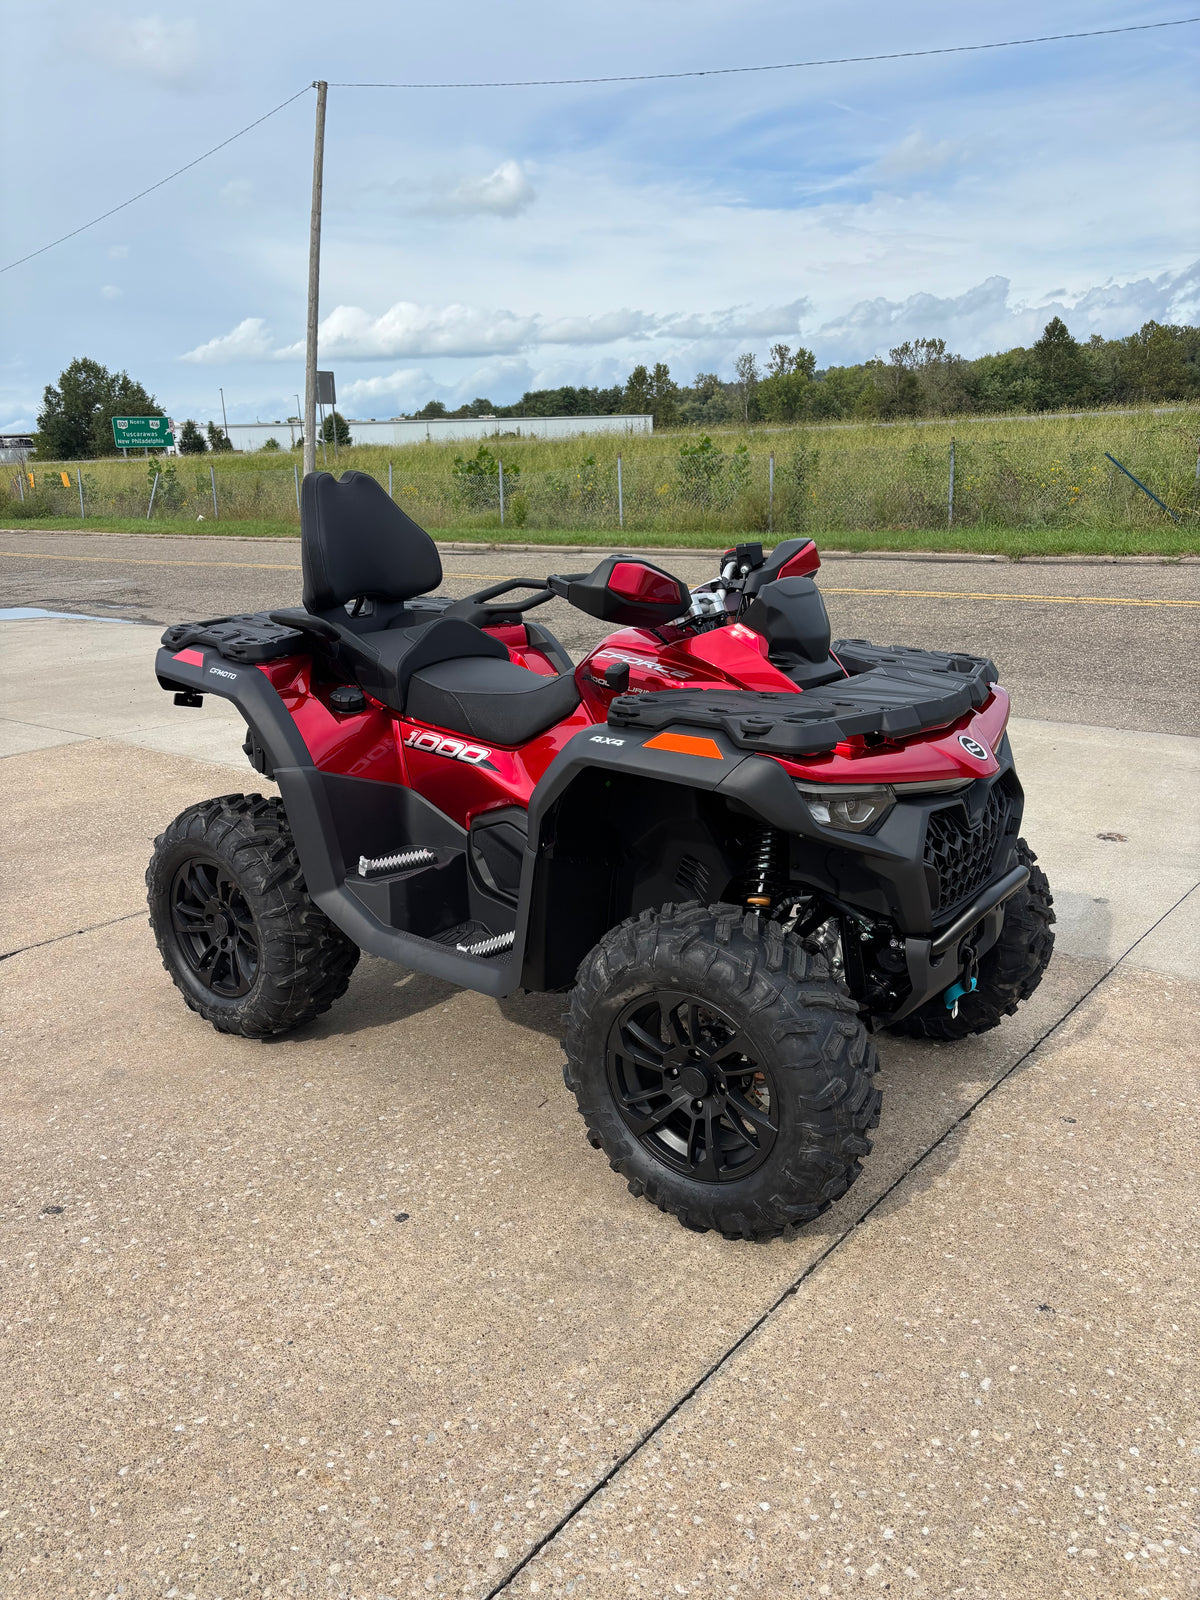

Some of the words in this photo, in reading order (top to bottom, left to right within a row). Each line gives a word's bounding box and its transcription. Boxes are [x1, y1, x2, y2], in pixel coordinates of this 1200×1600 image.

[209, 667, 237, 680] CFMOTO
[595, 650, 694, 679] CFORCE
[404, 730, 492, 764] 1000
